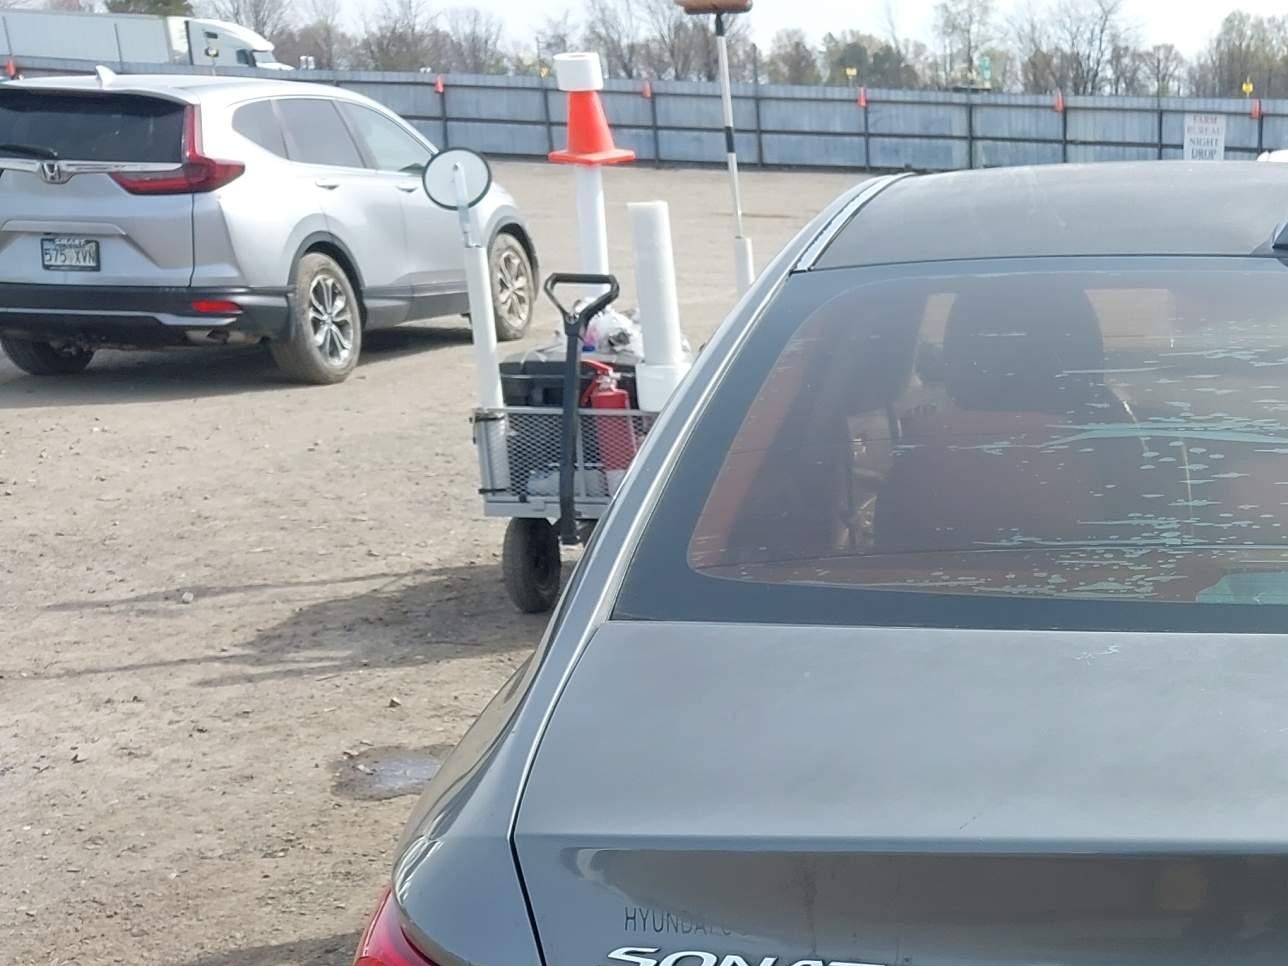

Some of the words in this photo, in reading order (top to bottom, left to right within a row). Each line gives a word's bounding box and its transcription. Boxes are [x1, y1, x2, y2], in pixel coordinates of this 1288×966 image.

[1189, 137, 1219, 147] NIGHT
[1191, 148, 1218, 160] DROP
[44, 247, 67, 264] 575
